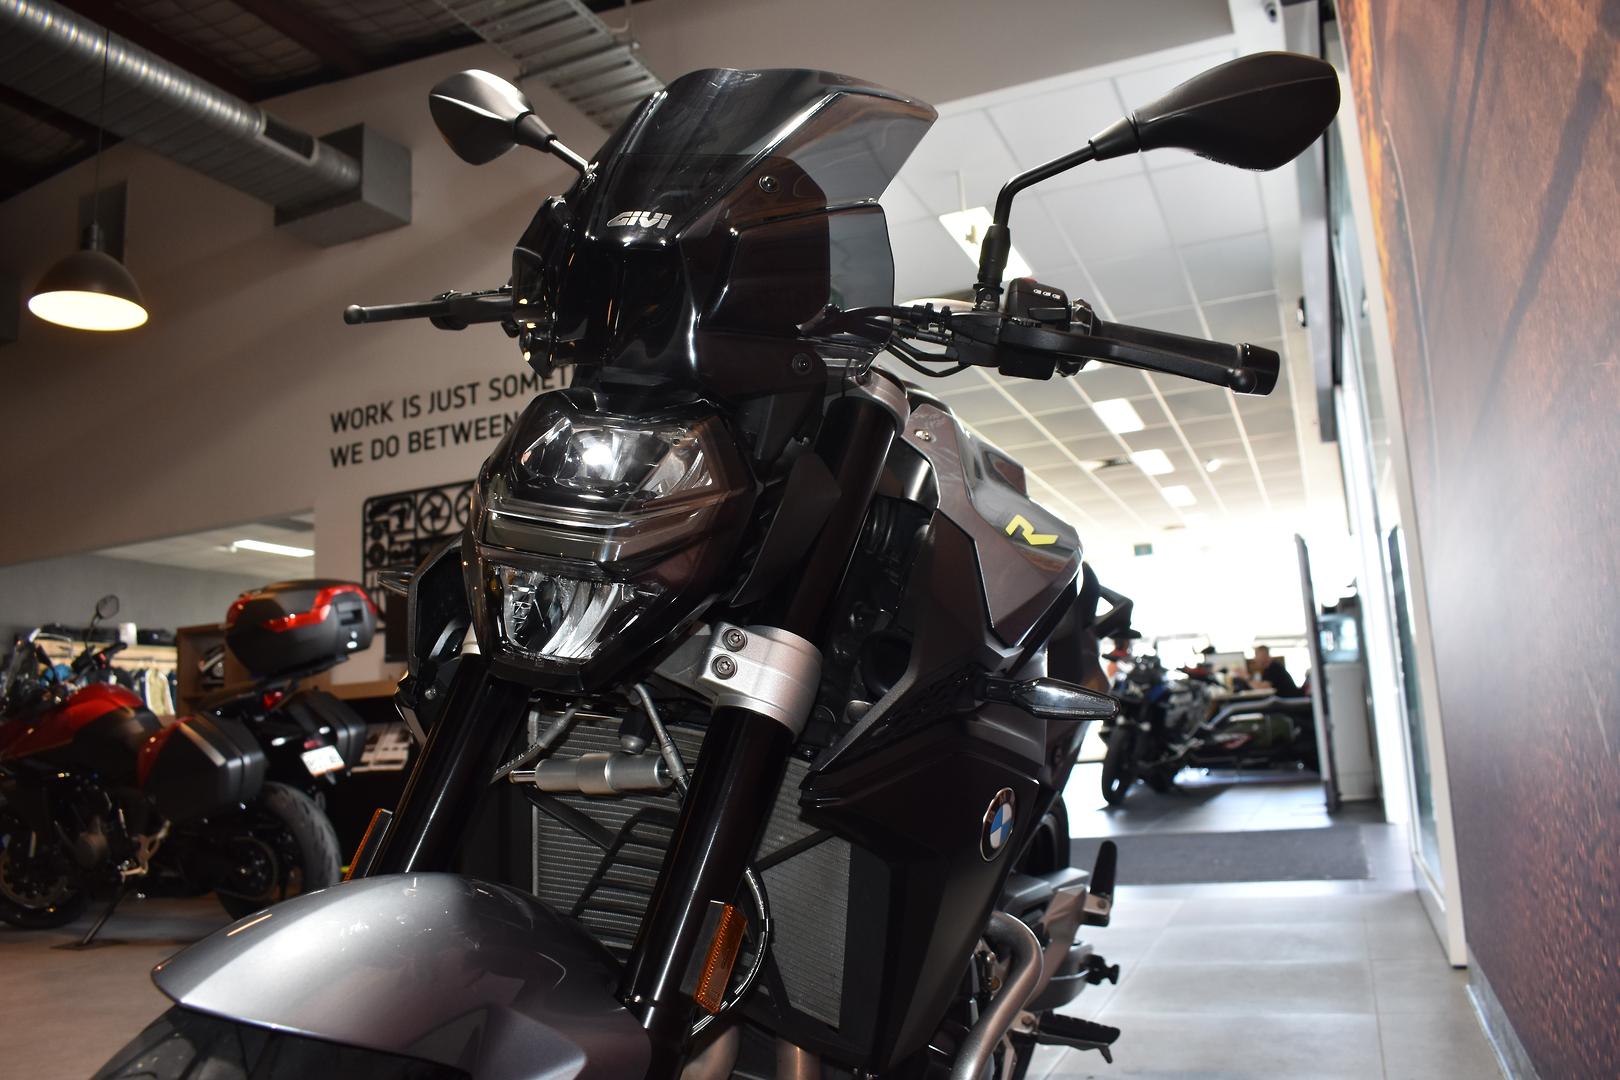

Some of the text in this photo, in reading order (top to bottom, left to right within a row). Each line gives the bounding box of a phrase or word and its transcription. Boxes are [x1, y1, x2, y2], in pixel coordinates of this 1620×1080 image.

[607, 210, 672, 229] GIVI
[330, 363, 577, 434] WORK IS JUST SOMET
[330, 441, 363, 469] WE
[371, 434, 400, 461] DO
